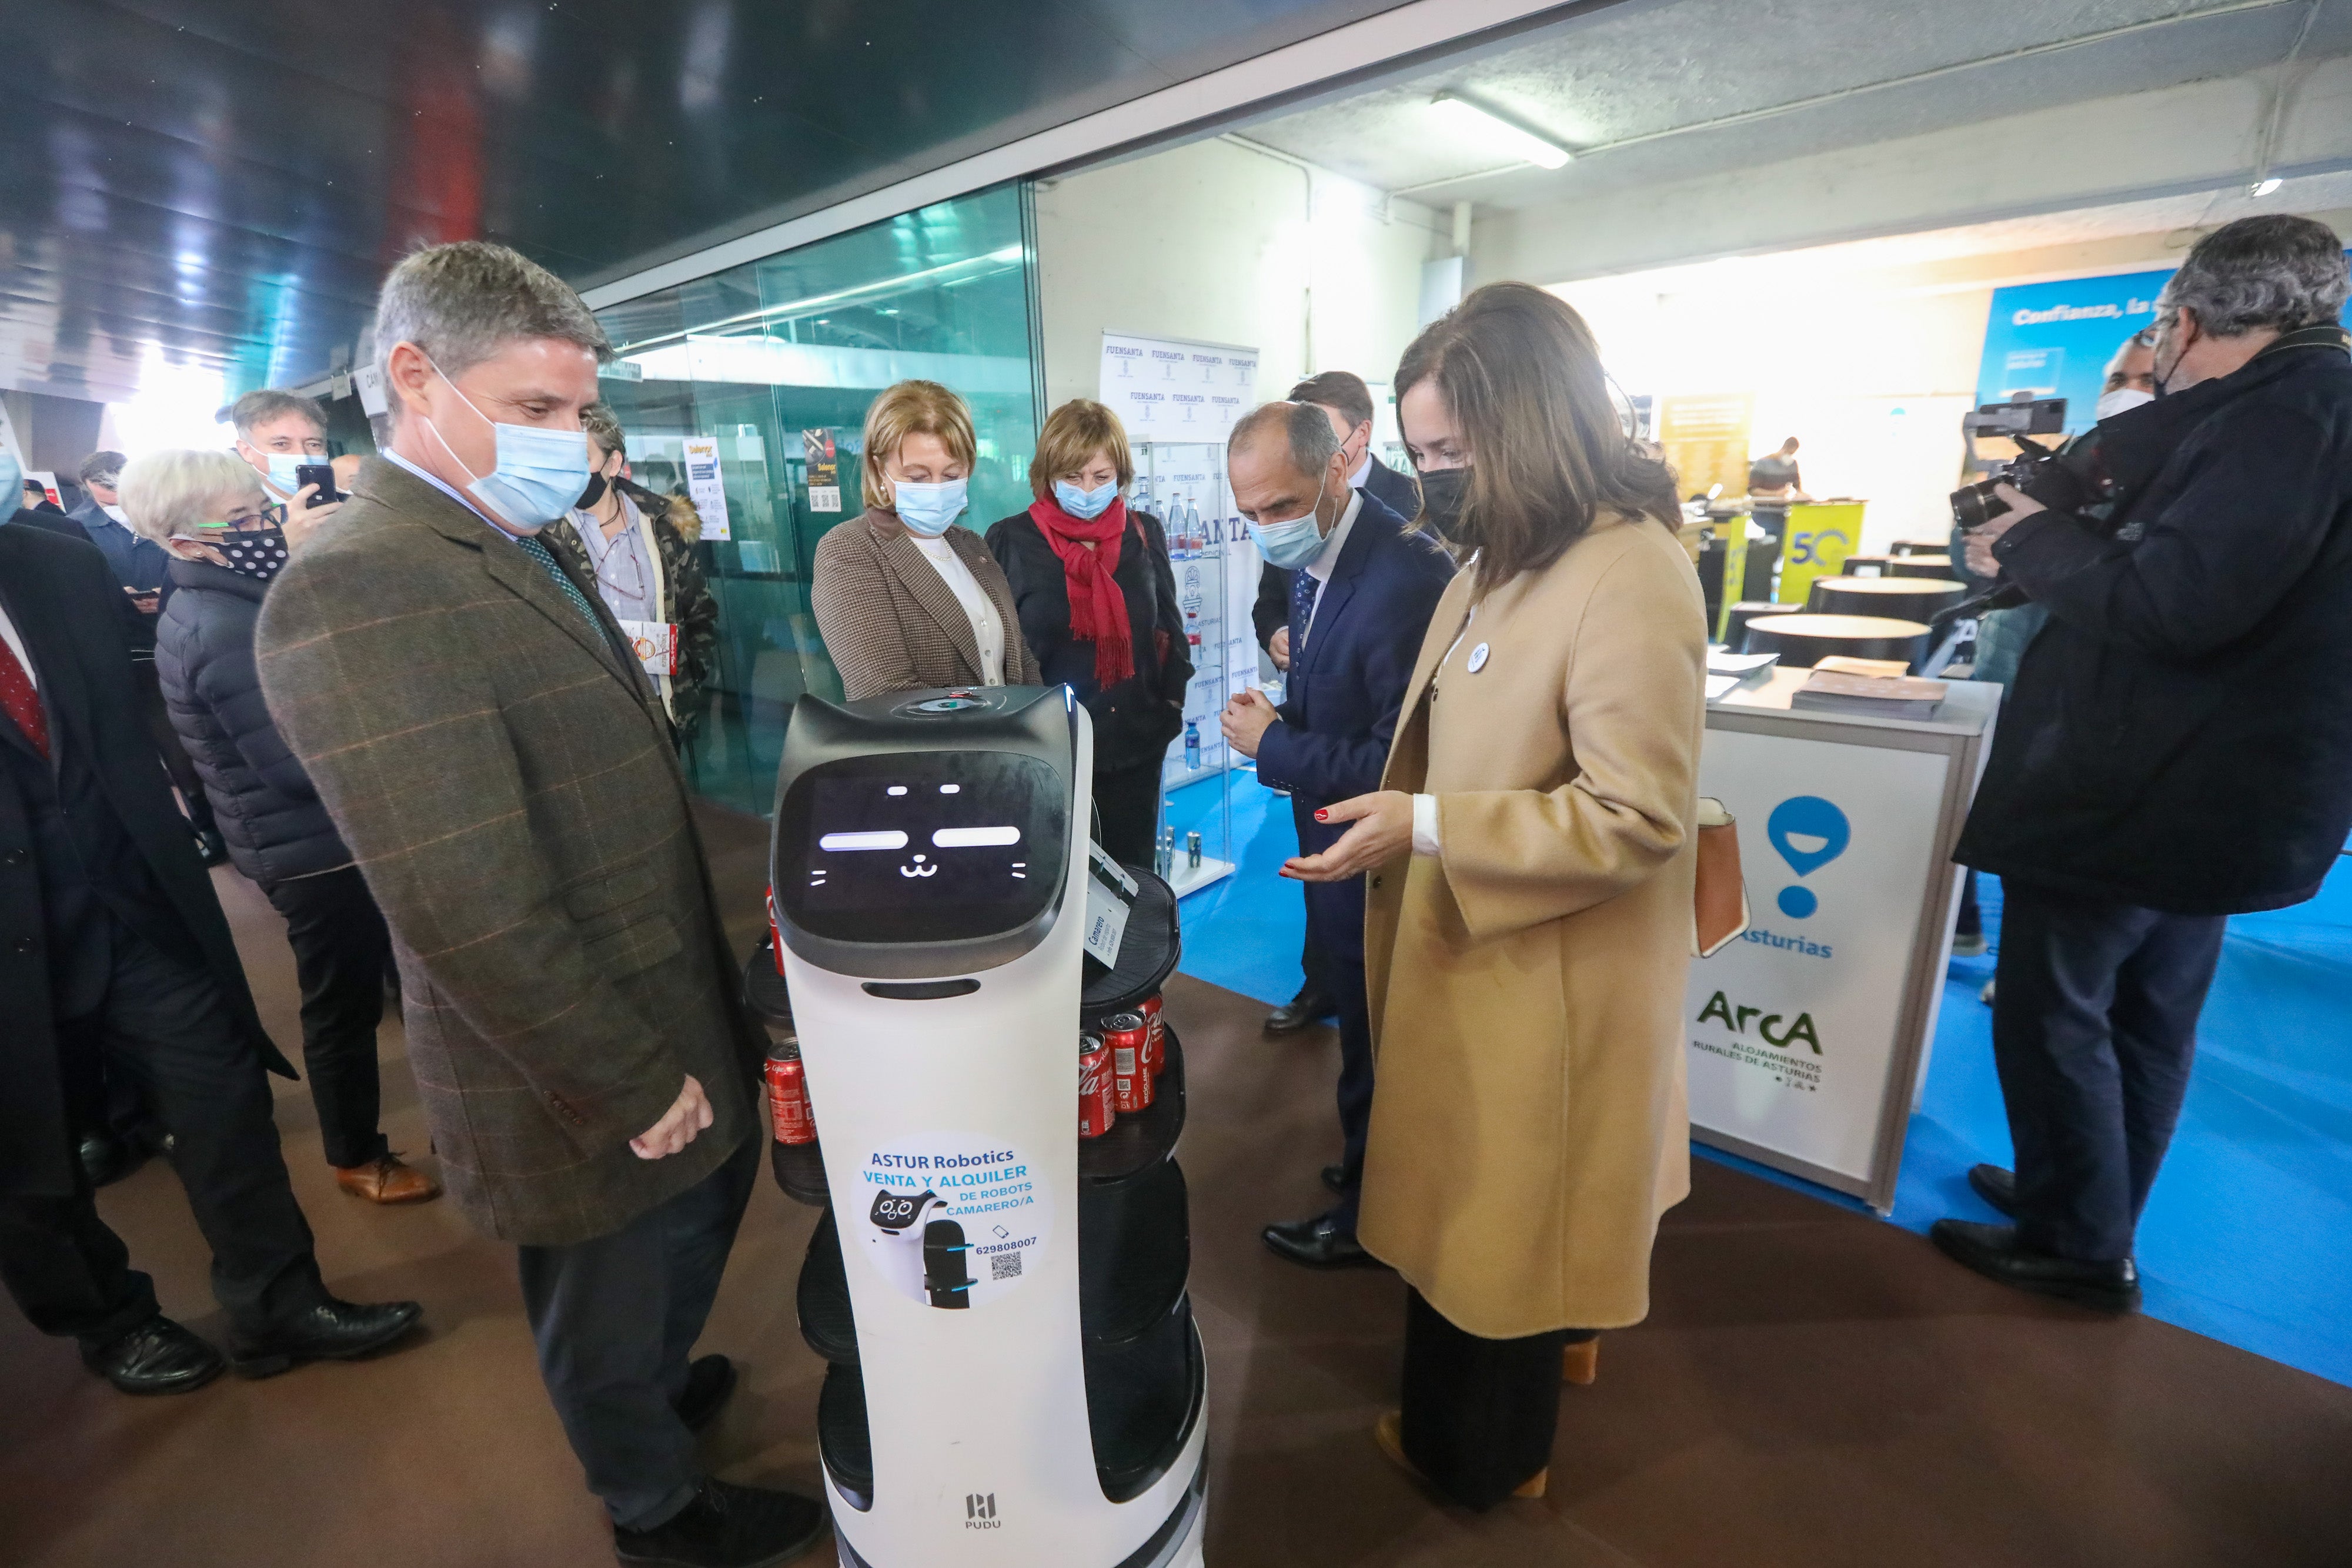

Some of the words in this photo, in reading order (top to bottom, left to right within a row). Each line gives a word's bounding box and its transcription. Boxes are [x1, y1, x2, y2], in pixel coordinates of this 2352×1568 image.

[1106, 346, 1143, 357] FUENSANTA
[1152, 350, 1185, 360] FUENSANTA
[1192, 355, 1222, 364] FUENSANTA
[1229, 359, 1257, 367] FUENSANTA
[1131, 392, 1165, 401] FUENSANTA
[1172, 394, 1205, 403] FUENSANTA
[1212, 396, 1240, 404] FUENSANTA
[1173, 473, 1205, 482] FUENSANTA
[1088, 916, 1104, 945] Camarero
[1694, 1040, 1742, 1061] RURALES
[1745, 1056, 1759, 1067] DE
[1763, 1061, 1820, 1083] ASTURIAS
[1733, 1042, 1822, 1074] ALOJAMIENTOS
[871, 1153, 930, 1169] ASTUR
[934, 1150, 1014, 1168] Robotics
[863, 1171, 916, 1188] VENTA
[923, 1176, 933, 1188] Y
[940, 1165, 1027, 1188] ALQUILER
[960, 1192, 977, 1201] DE
[981, 1182, 1033, 1200] ROBOTS
[947, 1195, 1034, 1216] CAMARERO/A
[976, 1236, 1037, 1255] 629808007
[965, 1520, 1001, 1529] PUDU
